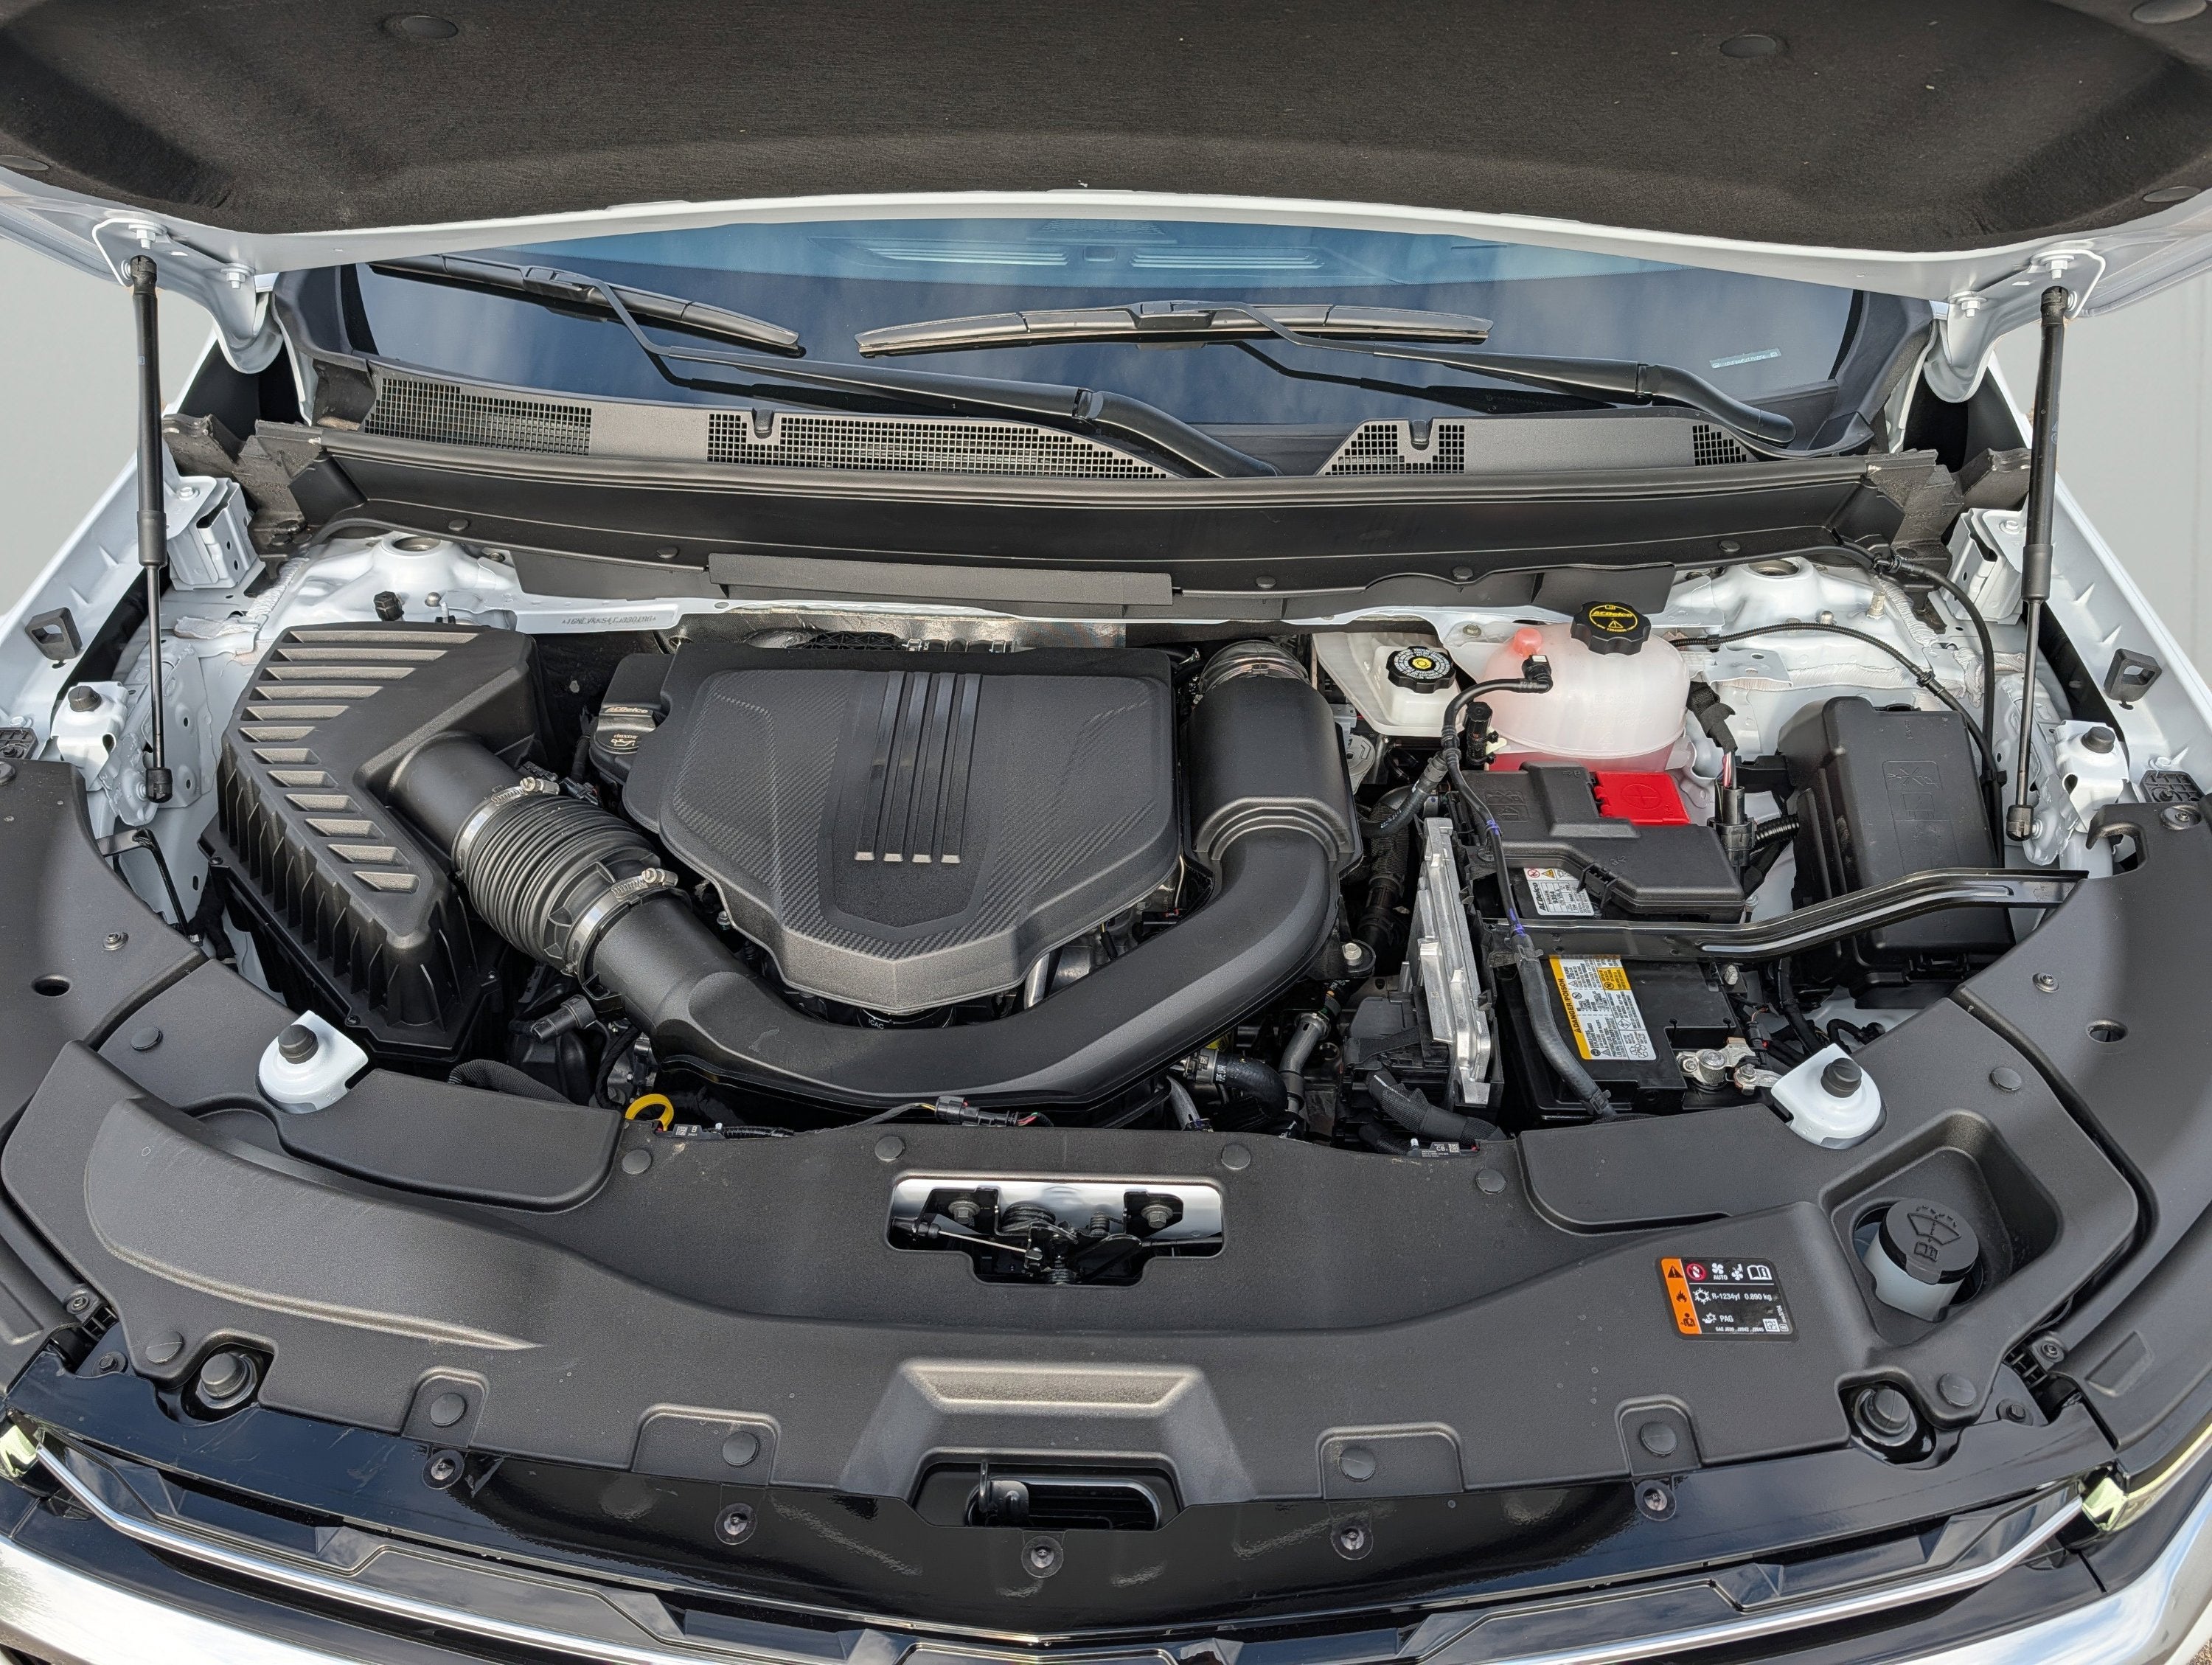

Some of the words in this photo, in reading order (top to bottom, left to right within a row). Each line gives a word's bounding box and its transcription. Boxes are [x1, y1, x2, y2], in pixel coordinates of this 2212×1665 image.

[1532, 882, 1546, 911] ACDelco
[1550, 891, 1559, 903] 9354
[1557, 978, 1579, 1028] DANGER/POISON
[869, 1018, 884, 1029] ICAC
[1763, 1293, 1772, 1301] kg
